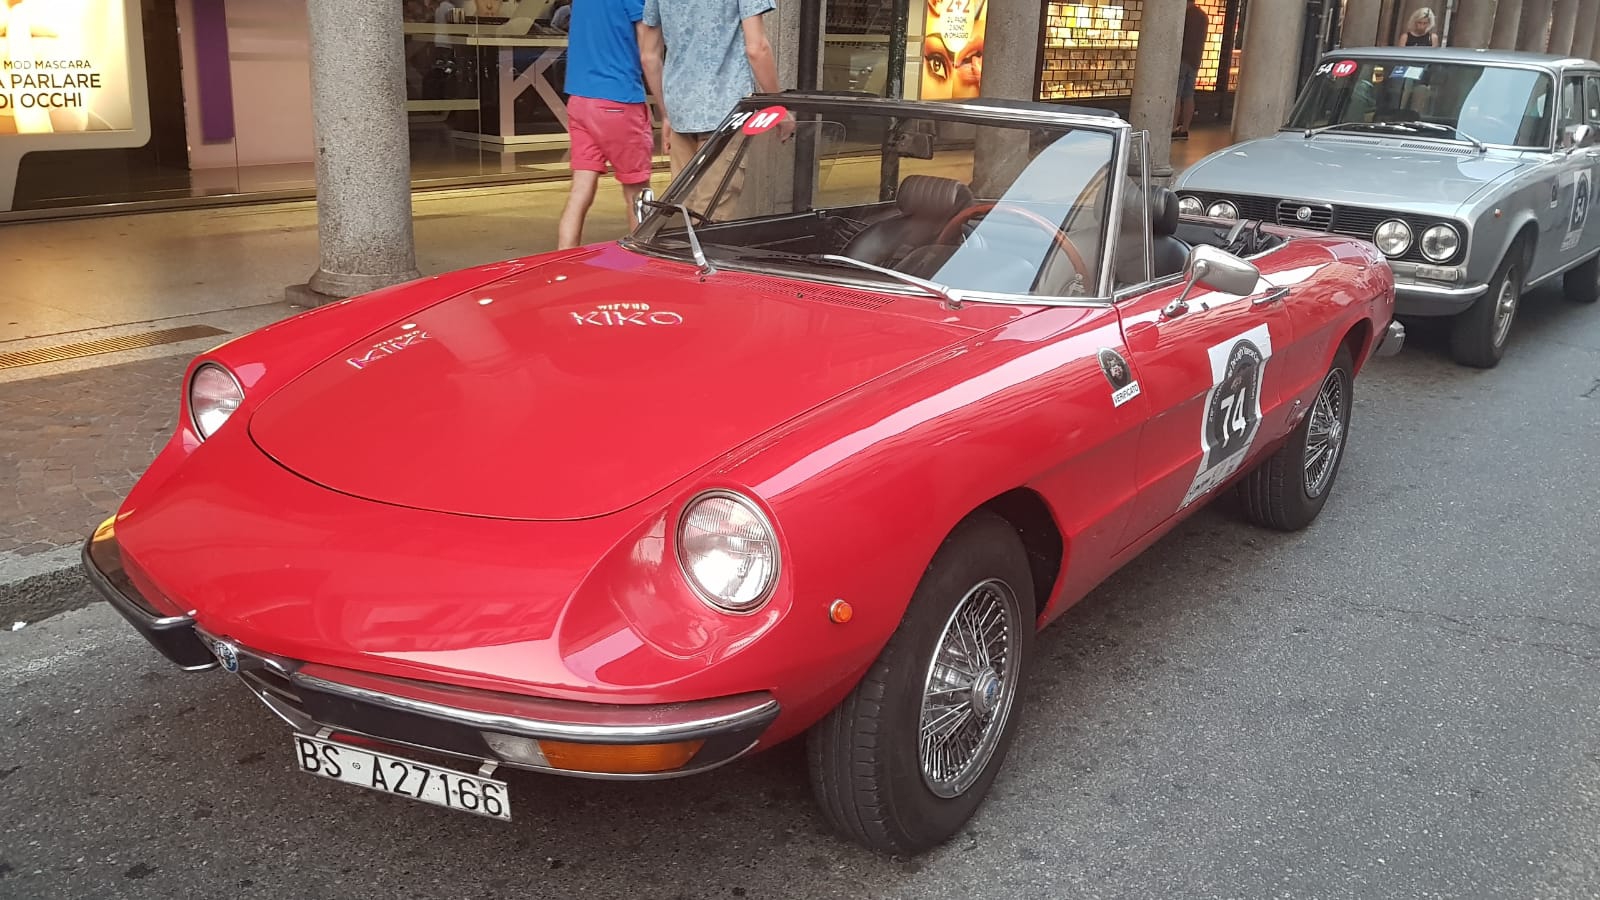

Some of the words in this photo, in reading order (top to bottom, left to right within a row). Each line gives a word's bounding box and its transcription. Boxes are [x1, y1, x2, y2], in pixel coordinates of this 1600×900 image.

[3, 60, 31, 70] MOD
[35, 60, 92, 69] MASCARA
[1315, 62, 1335, 76] 54
[1336, 63, 1353, 73] M
[10, 73, 101, 89] PARLARE
[20, 92, 82, 108] OCCHI
[720, 111, 754, 132] 74
[748, 112, 780, 128] M
[1113, 383, 1140, 404] VERIFICATO
[1220, 387, 1247, 448] 74
[300, 737, 343, 778] BS
[372, 755, 504, 816] A27166
